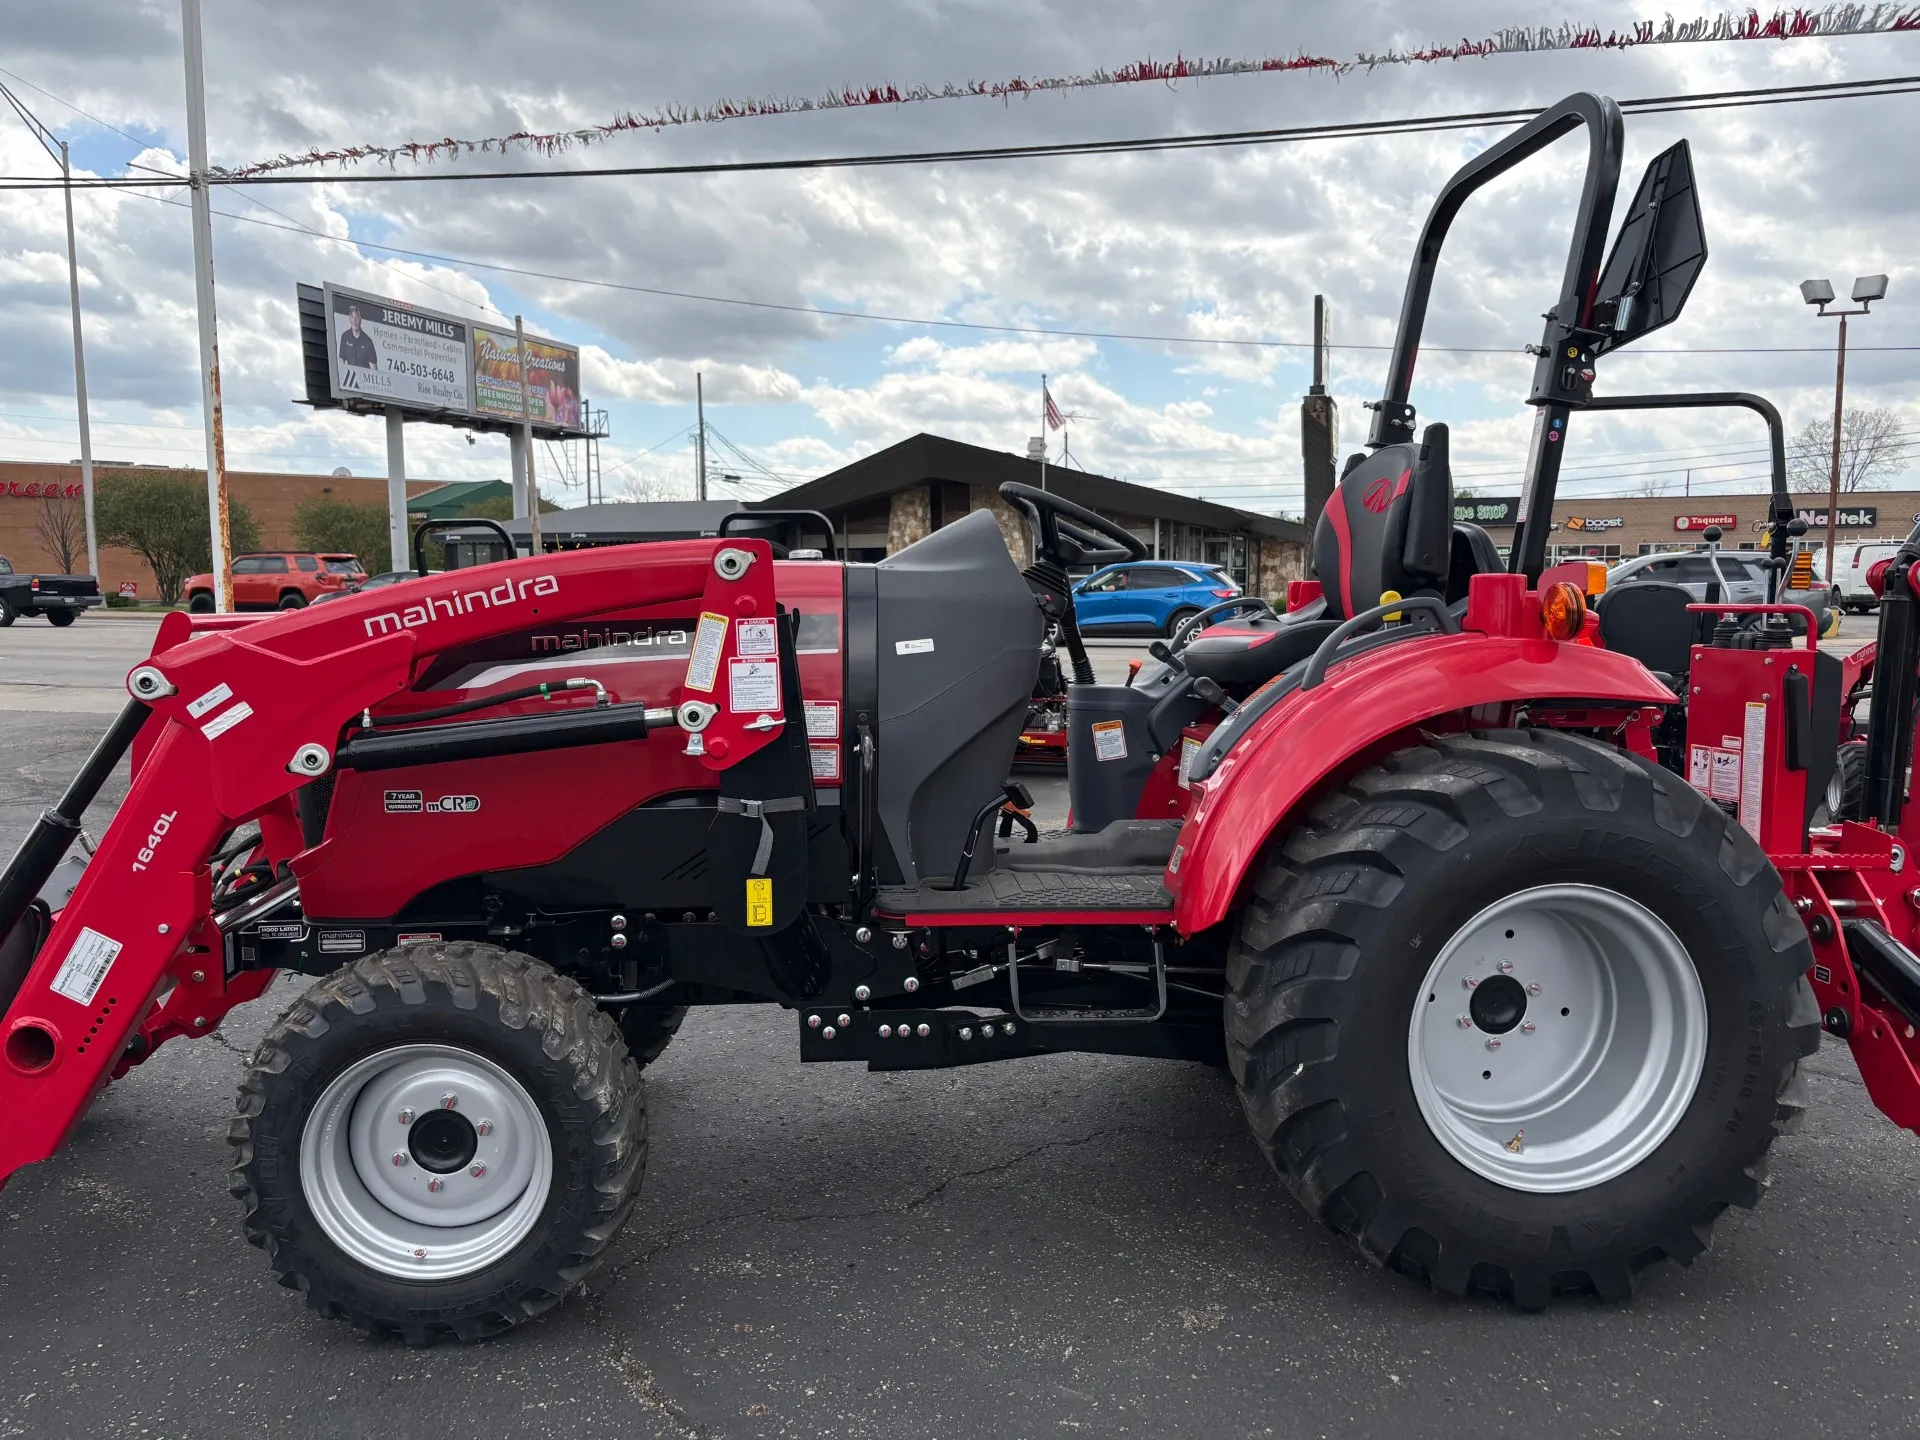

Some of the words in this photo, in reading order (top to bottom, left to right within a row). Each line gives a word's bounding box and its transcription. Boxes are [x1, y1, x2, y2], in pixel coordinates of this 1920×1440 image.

[382, 309, 423, 330] JEREMY
[425, 319, 454, 337] MILLS
[373, 327, 397, 340] Homes
[442, 342, 463, 354] Cabins
[382, 340, 423, 357] Commercial
[424, 349, 457, 363] Properties
[480, 341, 521, 364] Natura
[524, 349, 566, 372] Creations
[363, 373, 392, 387] MILLS
[387, 358, 455, 383] 740-503-6648
[418, 383, 431, 394] Rise
[432, 386, 453, 402] Realty
[453, 389, 464, 400] Co.
[1477, 504, 1508, 520] SHOP
[1586, 517, 1622, 527] boost
[1691, 516, 1733, 525] Taqueria
[1800, 509, 1874, 526] Naltek
[364, 574, 559, 637] mahindra
[531, 627, 687, 650] mahindra
[132, 810, 178, 872] 1640L
